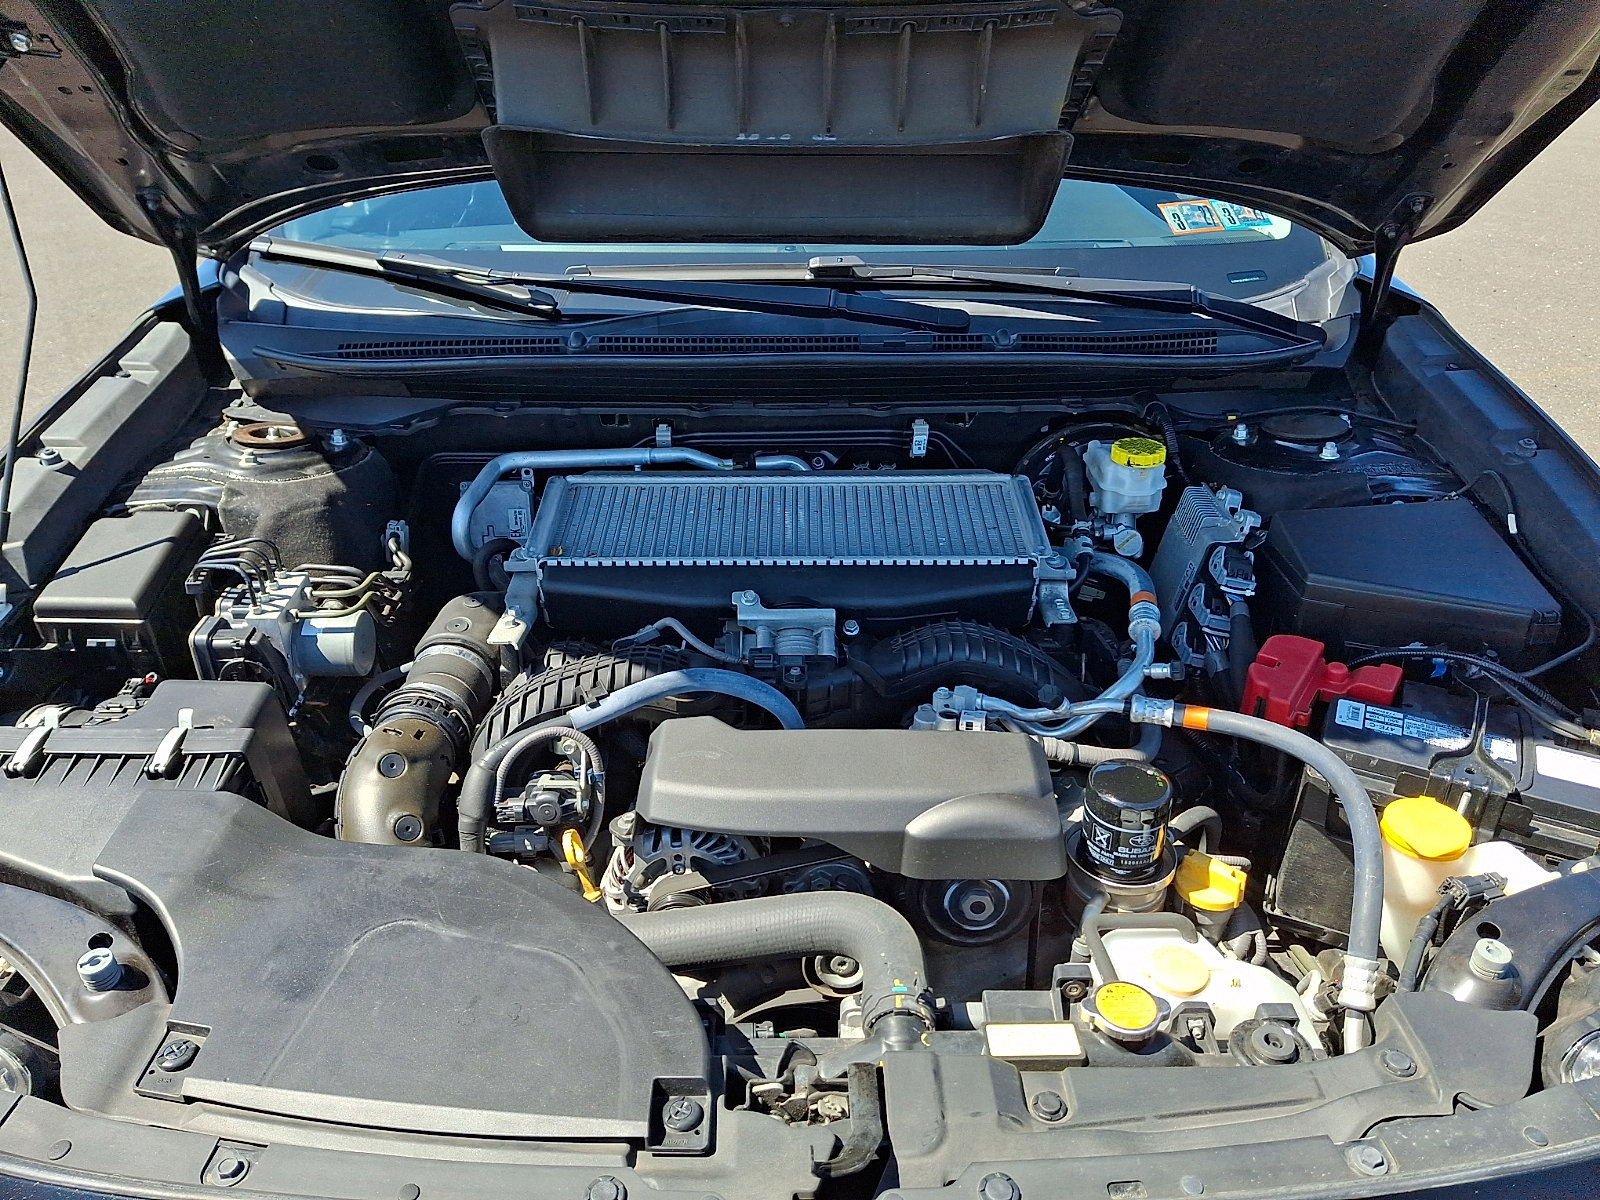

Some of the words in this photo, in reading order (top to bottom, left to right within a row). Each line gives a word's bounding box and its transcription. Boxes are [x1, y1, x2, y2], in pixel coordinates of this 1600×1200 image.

[1171, 212, 1187, 230] 3
[1221, 207, 1237, 225] 3
[510, 529, 521, 538] EK
[1118, 845, 1157, 854] SUBAR
